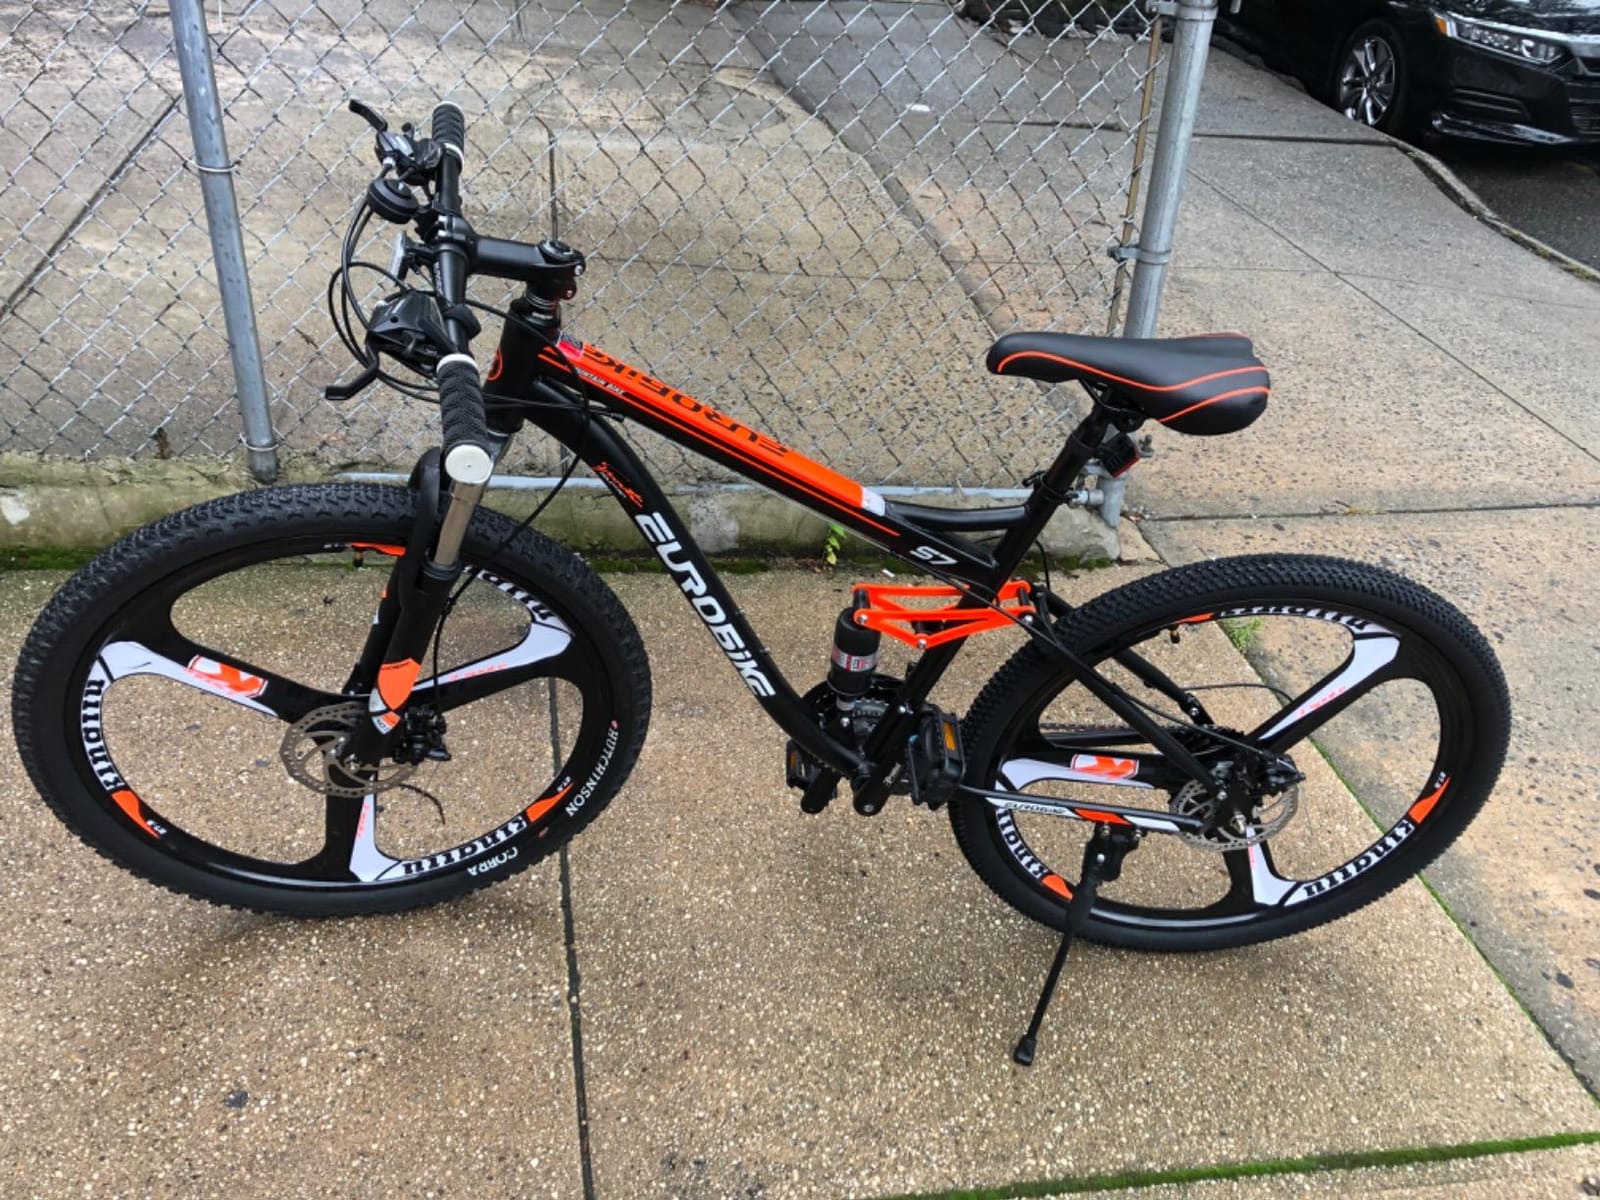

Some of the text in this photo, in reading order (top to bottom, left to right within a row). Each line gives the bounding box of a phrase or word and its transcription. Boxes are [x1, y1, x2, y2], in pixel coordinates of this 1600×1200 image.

[908, 546, 958, 566] S7
[566, 727, 619, 818] HUTCHINSON
[467, 849, 519, 877] COBRA
